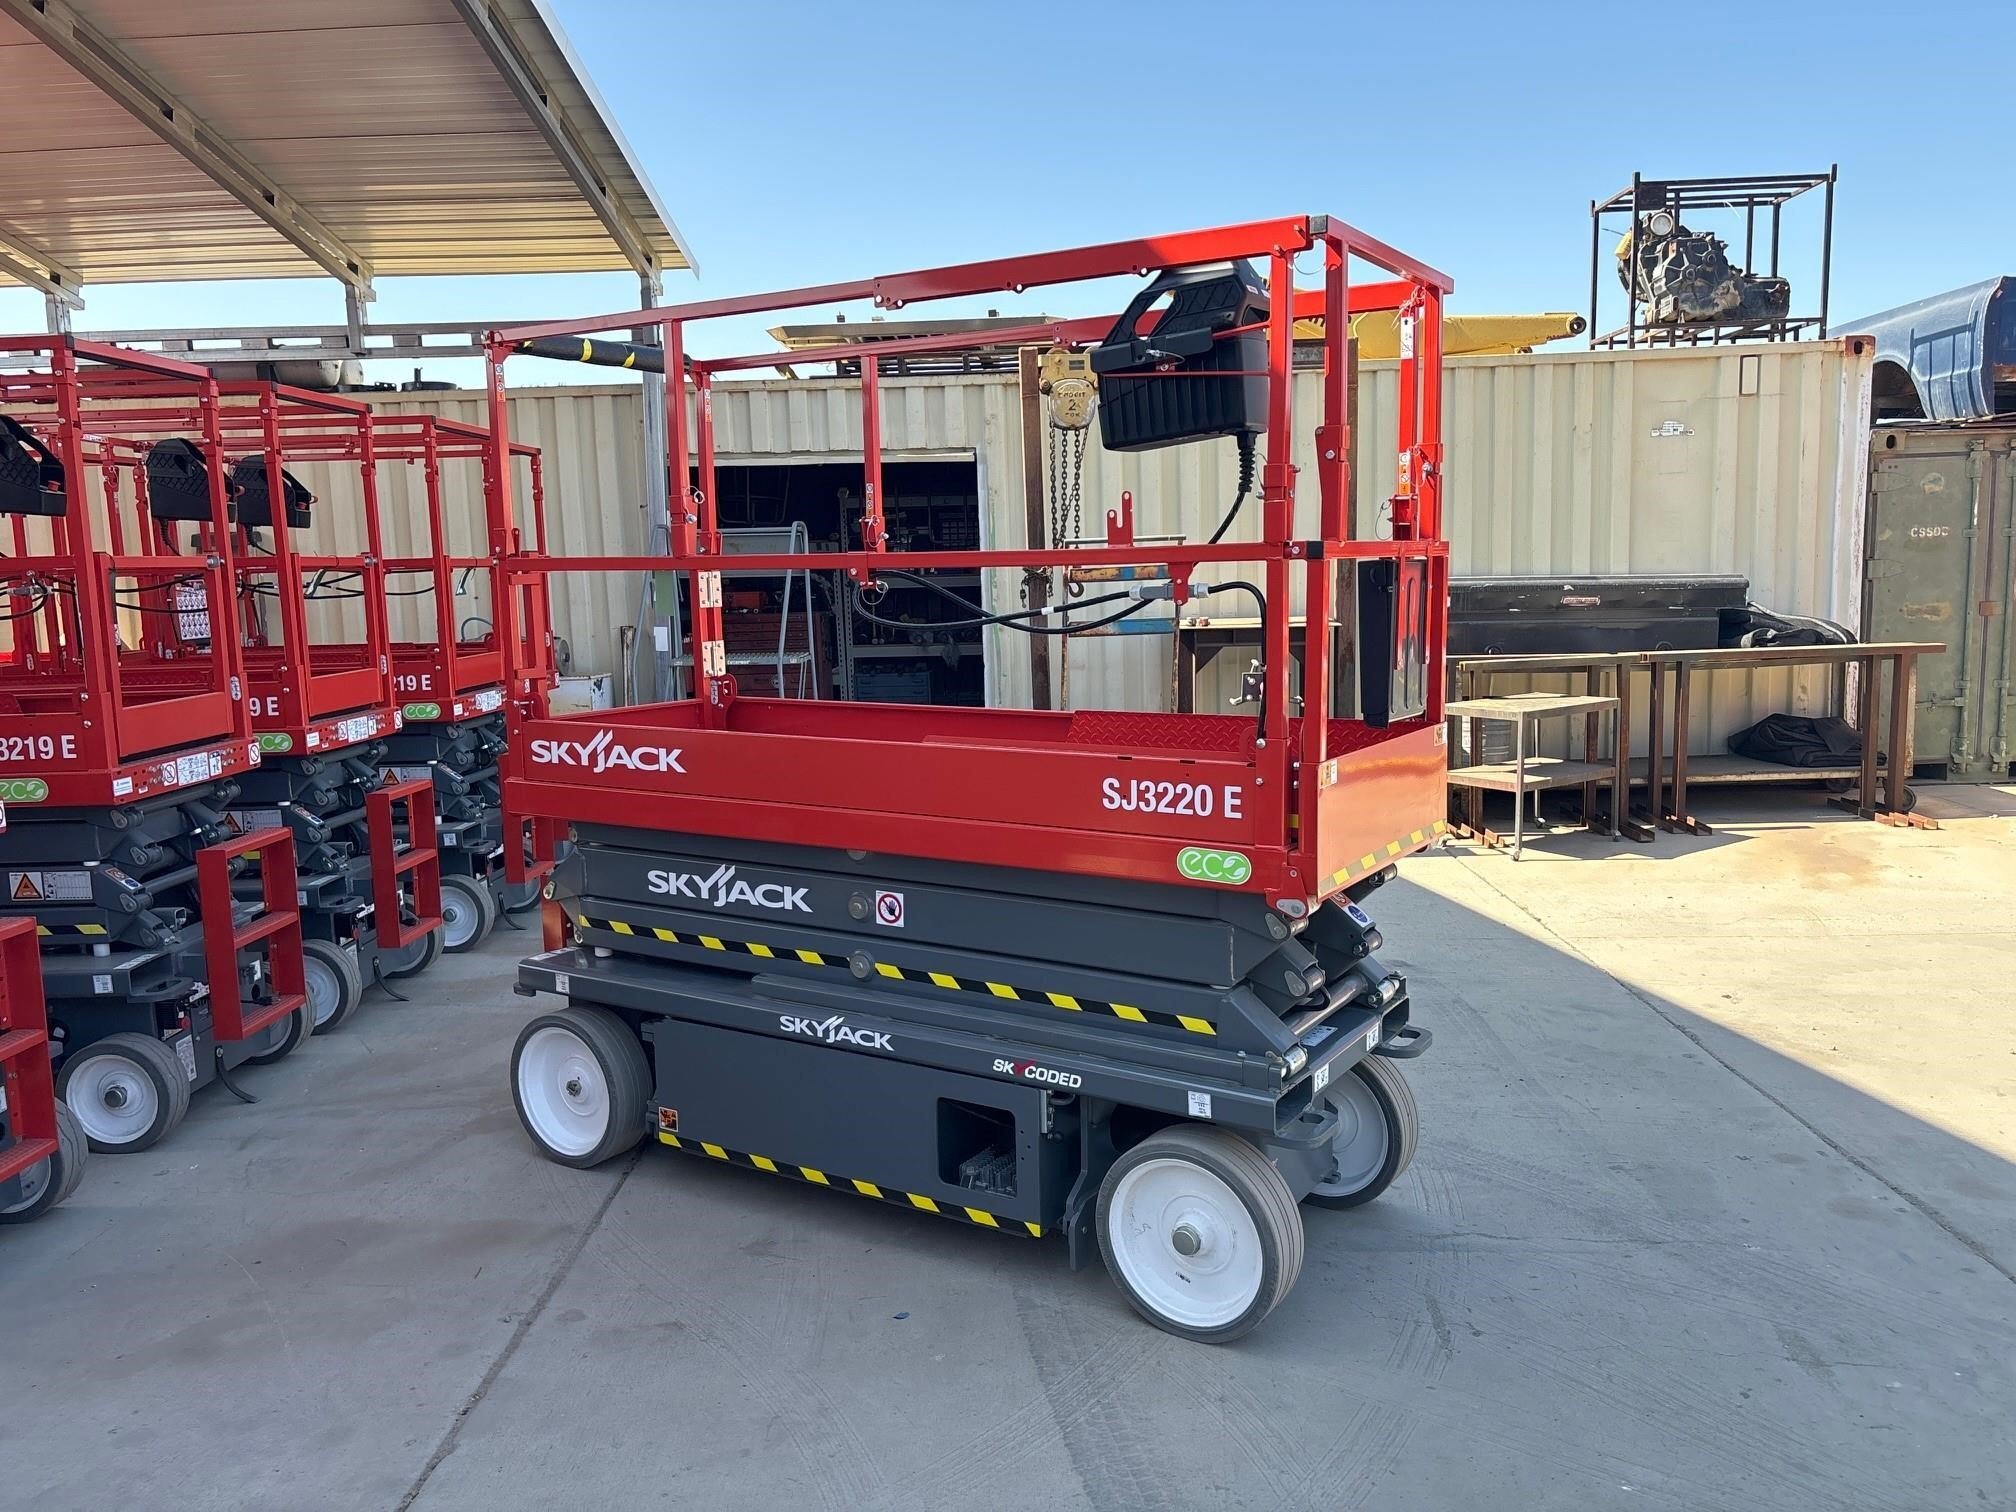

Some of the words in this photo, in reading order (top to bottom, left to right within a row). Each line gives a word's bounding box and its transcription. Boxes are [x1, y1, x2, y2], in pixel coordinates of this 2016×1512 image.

[1068, 399, 1077, 411] 2
[421, 674, 432, 691] E
[266, 696, 280, 716] E
[61, 734, 78, 759] E
[530, 728, 688, 774] SKYJACK
[1102, 777, 1214, 817] SJ3220
[1224, 785, 1243, 819] E
[1182, 850, 1247, 880] eco
[647, 863, 814, 913] SKYJACK
[779, 1015, 895, 1052] SKYJACK
[992, 1058, 1082, 1088] SKYCODED
